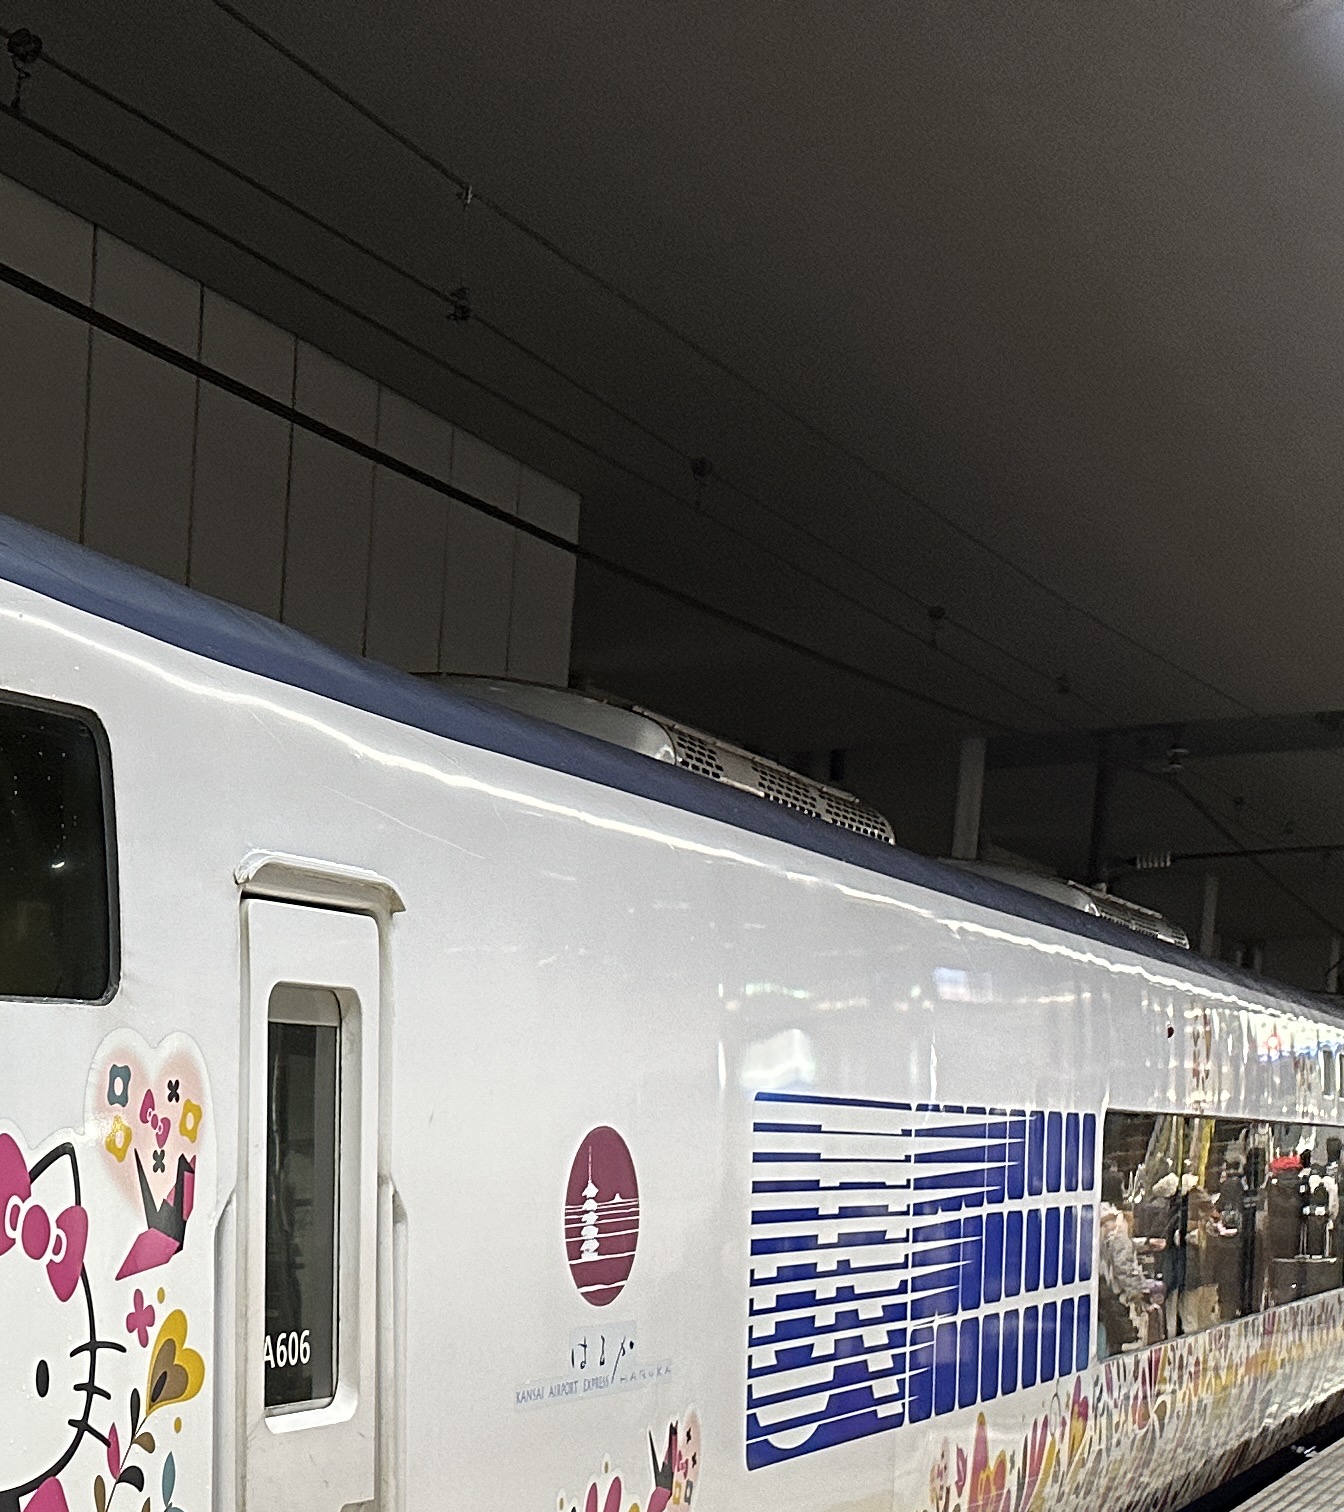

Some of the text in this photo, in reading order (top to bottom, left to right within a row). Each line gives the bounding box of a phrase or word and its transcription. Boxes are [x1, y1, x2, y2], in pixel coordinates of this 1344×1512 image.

[515, 1389, 545, 1405] KANSAI
[548, 1380, 579, 1399] AIRPORT
[582, 1374, 610, 1393] EXPRESS
